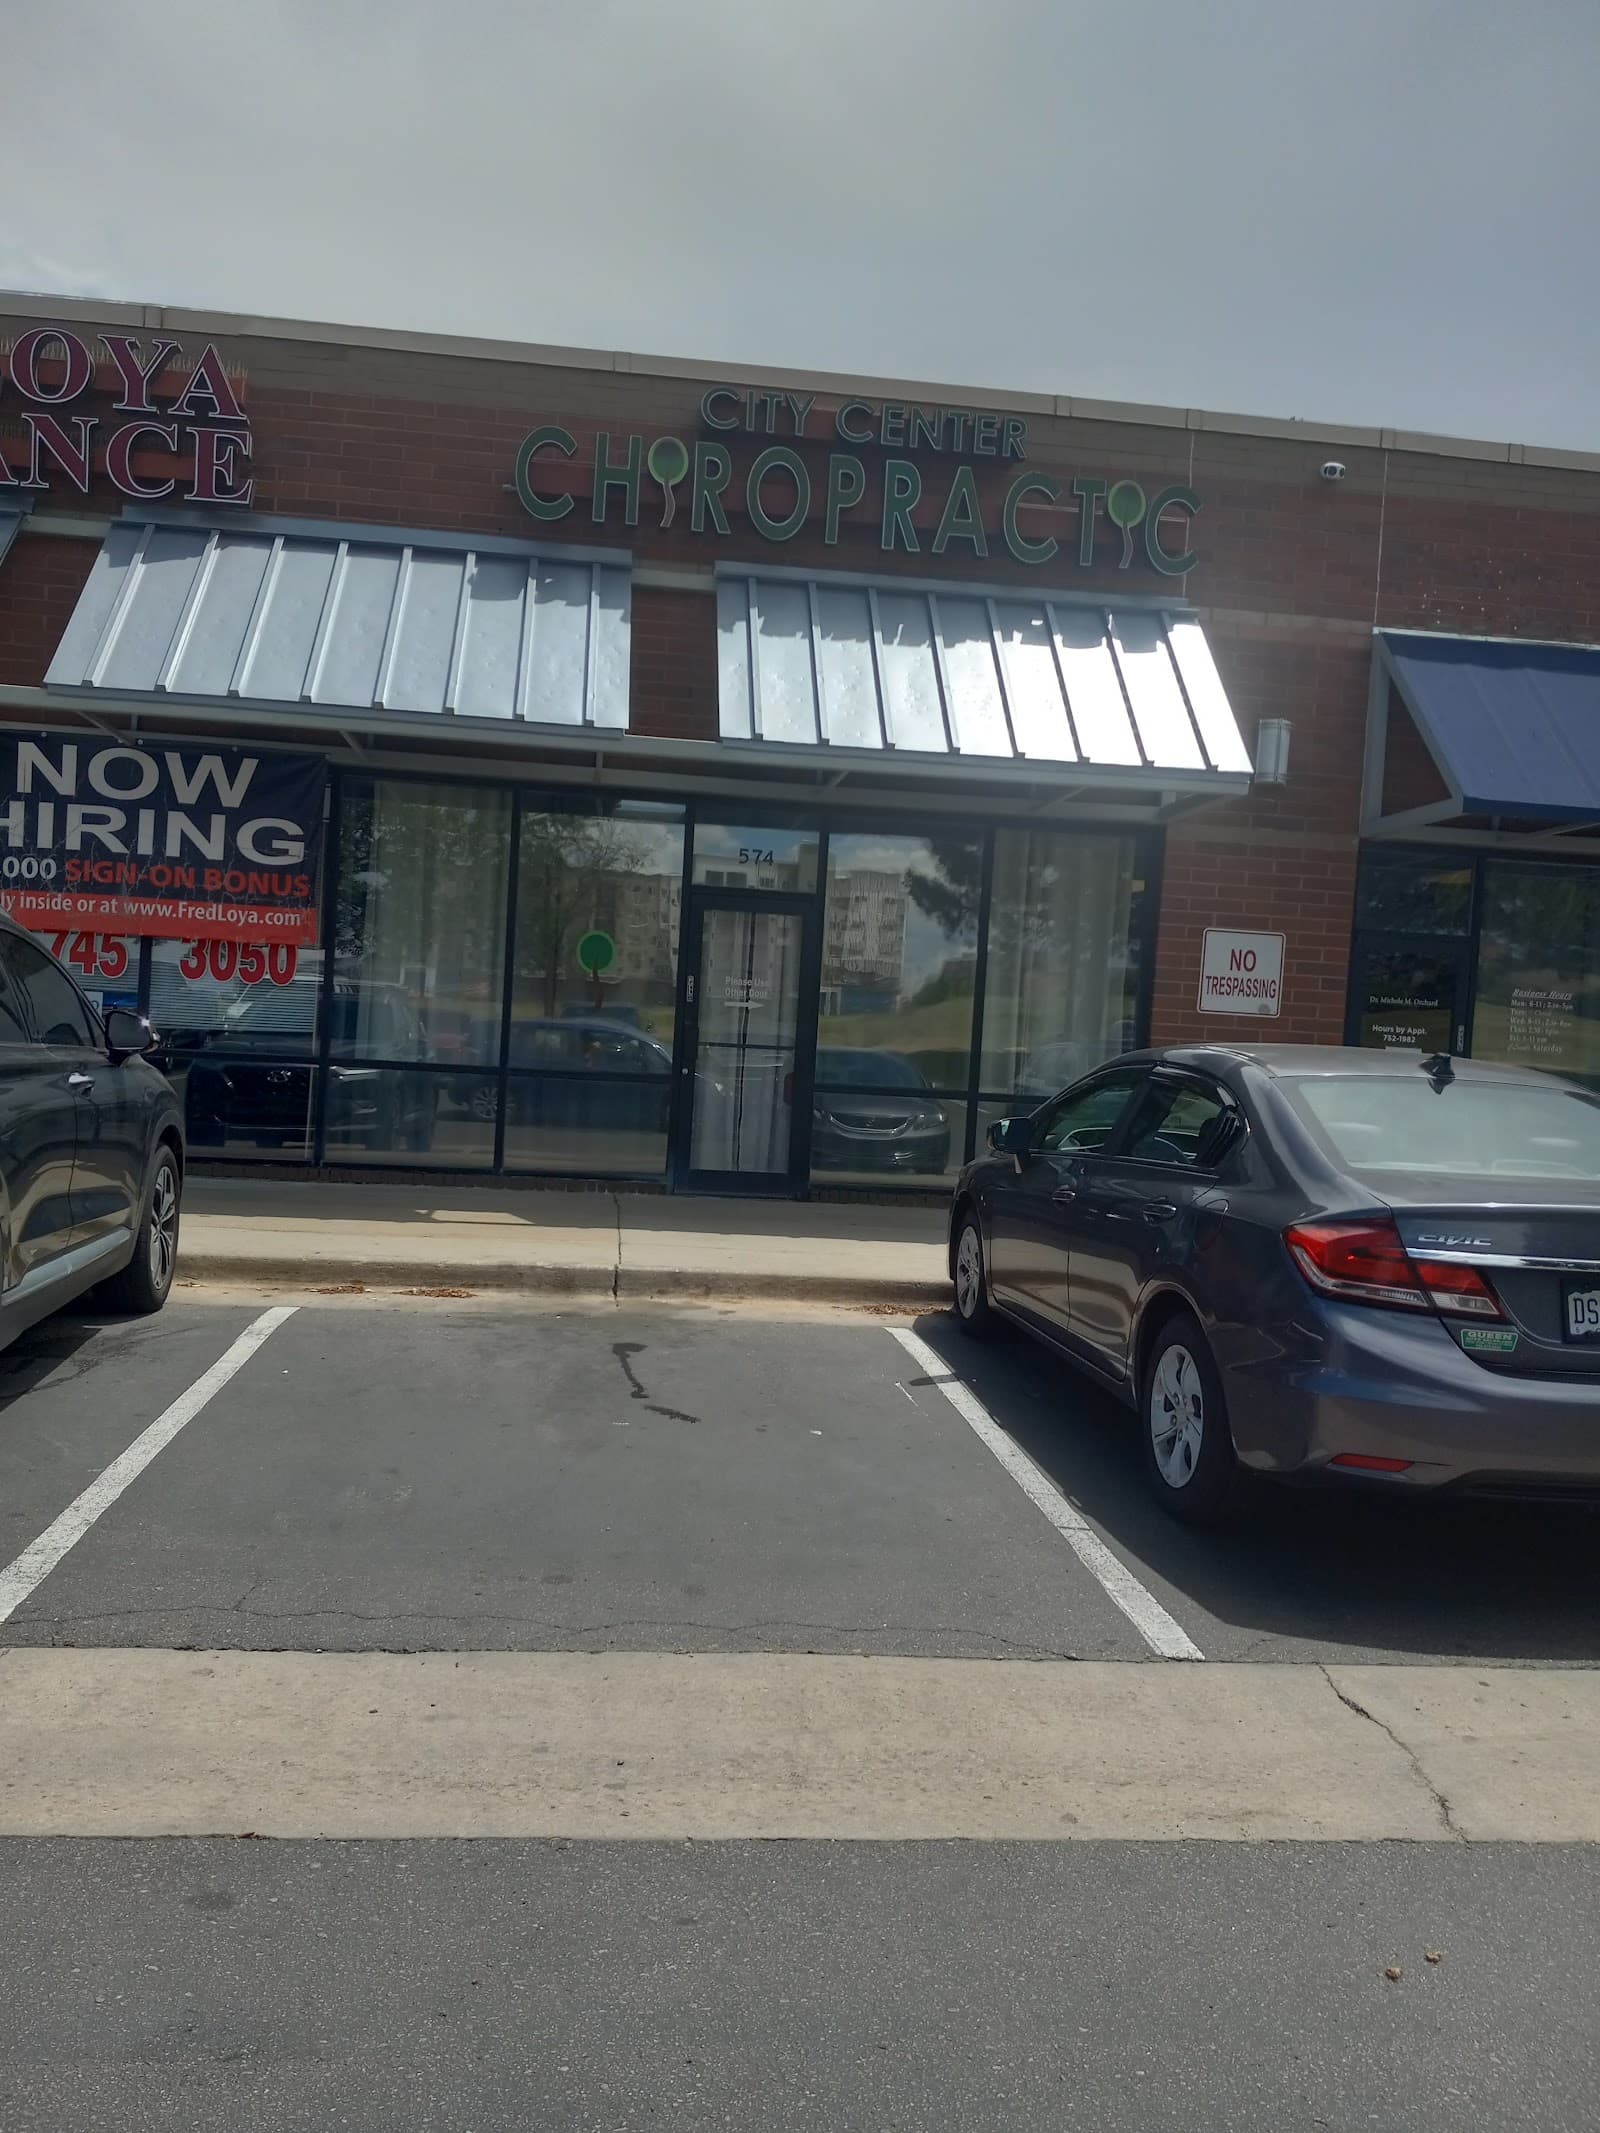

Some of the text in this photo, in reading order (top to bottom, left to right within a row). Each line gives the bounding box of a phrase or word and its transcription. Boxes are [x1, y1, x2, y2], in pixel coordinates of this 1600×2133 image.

[10, 327, 249, 421] OYA
[701, 386, 1029, 459] CITY CENTER
[0, 412, 253, 504] NCE
[16, 741, 259, 809] NOW
[738, 848, 774, 866] 574
[0, 857, 310, 898] 000 SIGN-ON BONUS
[19, 893, 72, 911] inside
[77, 899, 96, 912] or
[101, 899, 117, 914] at
[123, 901, 302, 927] www.FredLoya.com
[179, 937, 297, 987] 3050
[1230, 948, 1257, 973] NO
[1205, 975, 1278, 999] TRESPASSING
[1372, 1025, 1394, 1034] Hours
[1395, 1025, 1405, 1034] by
[1418, 1233, 1493, 1246] CIVIC
[1573, 1297, 1600, 1325] DS
